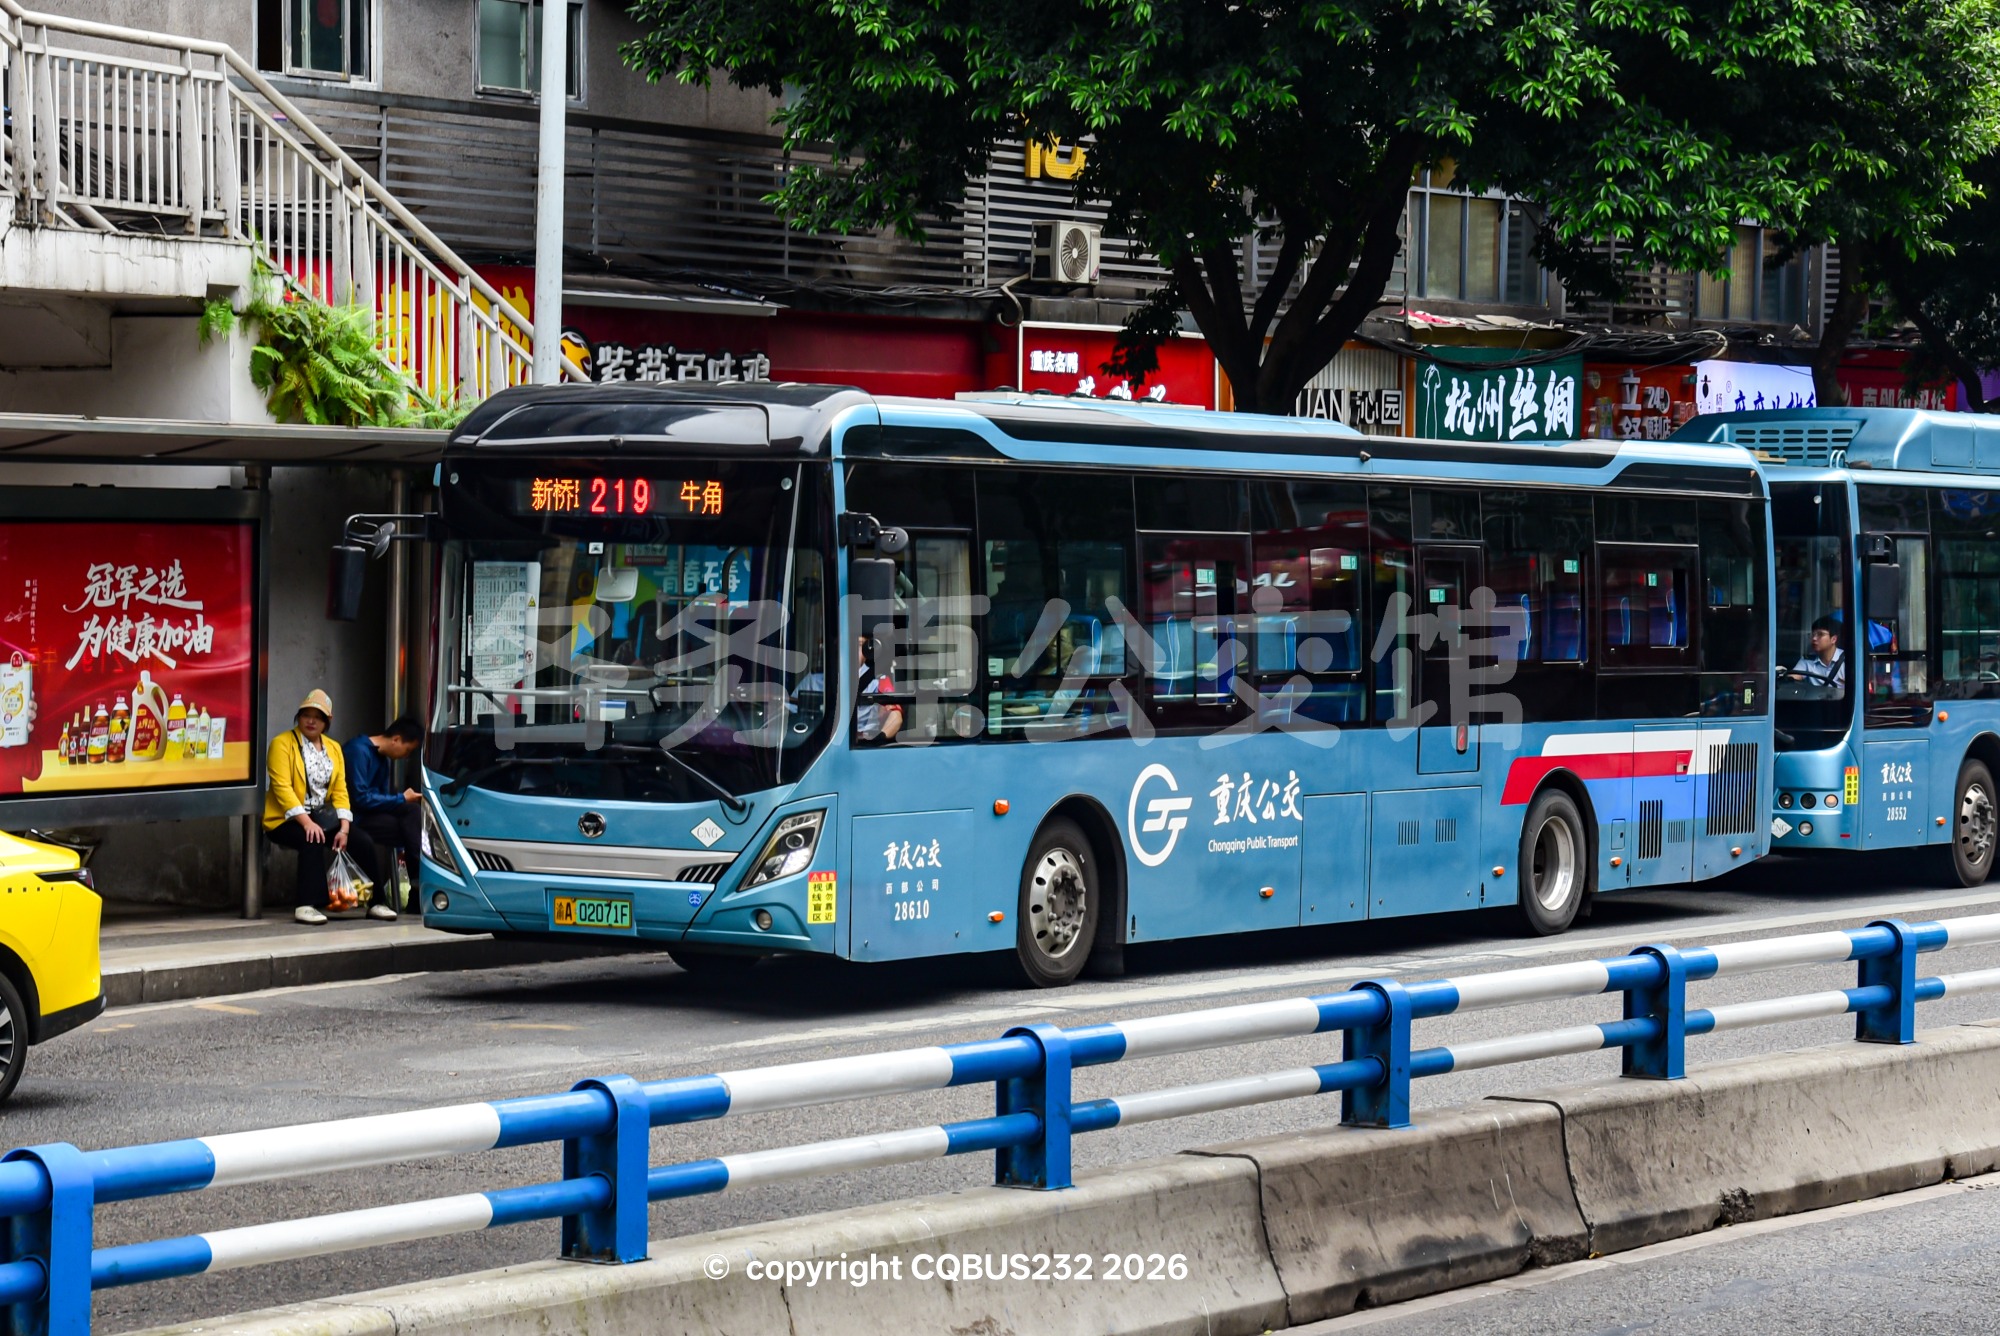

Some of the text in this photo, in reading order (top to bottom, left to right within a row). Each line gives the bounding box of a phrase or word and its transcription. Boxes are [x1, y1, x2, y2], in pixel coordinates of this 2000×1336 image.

[1287, 389, 1403, 425] UAN 沁园
[1444, 368, 1575, 440] 杭州丝绸
[591, 478, 650, 513] 219
[681, 480, 722, 514] 牛角
[62, 558, 203, 614] 冠军之选
[65, 612, 214, 671] 为健康加油
[1880, 761, 1913, 784] 重庆公交
[1209, 769, 1303, 826] 重庆公交
[1887, 806, 1906, 821] 28552
[696, 826, 719, 840] CNG
[1208, 834, 1299, 854] Chongqing Public Transport
[883, 838, 942, 872] 重庆公交
[885, 878, 939, 895] 西部公司
[579, 902, 629, 924] 02071F
[894, 899, 930, 922] 28610
